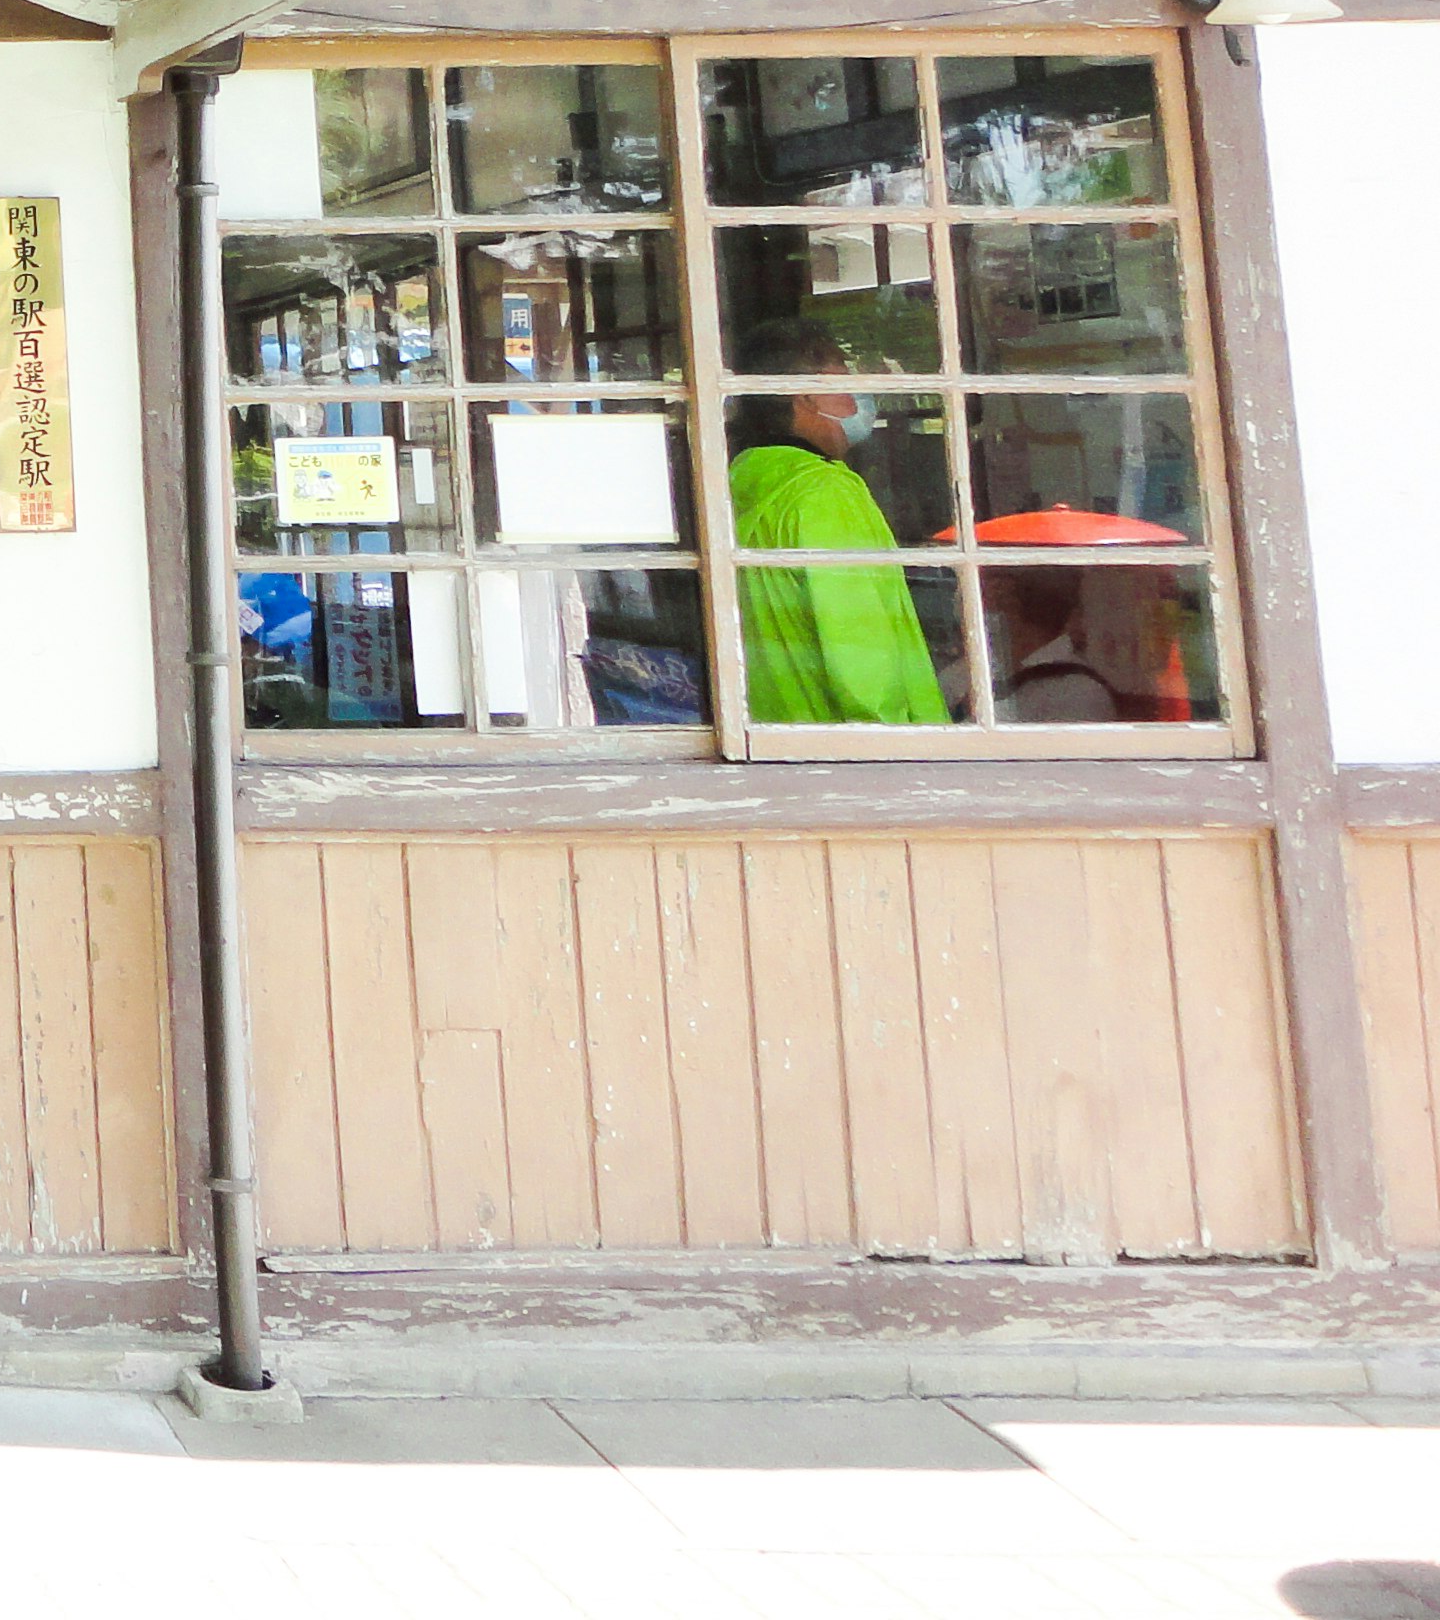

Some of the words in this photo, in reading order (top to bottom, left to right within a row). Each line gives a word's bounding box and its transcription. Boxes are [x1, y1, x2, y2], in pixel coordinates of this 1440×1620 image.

[7, 206, 54, 489] 関東の駅百選認定駅
[289, 455, 322, 468] こども
